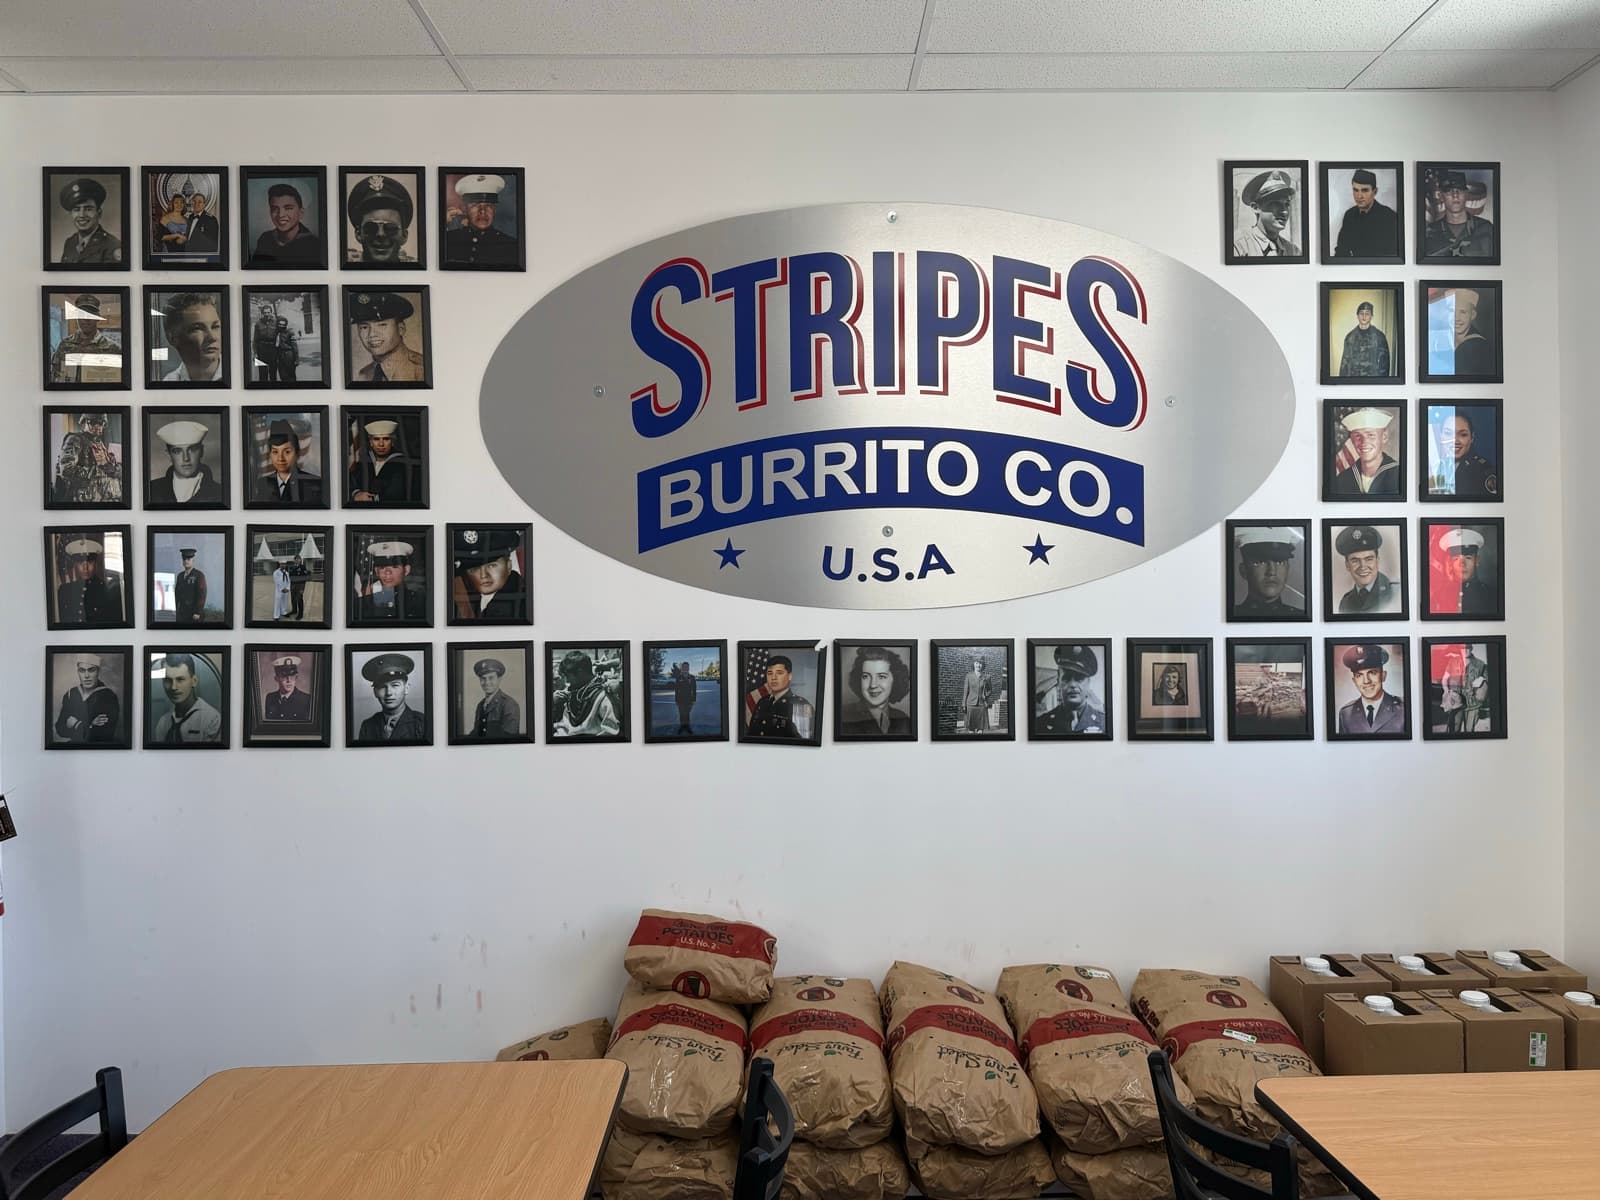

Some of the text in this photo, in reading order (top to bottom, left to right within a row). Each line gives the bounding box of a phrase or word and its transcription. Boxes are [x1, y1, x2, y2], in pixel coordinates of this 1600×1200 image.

[630, 250, 1148, 438] STRIPES
[659, 439, 1134, 530] BURRITO CO.
[822, 543, 955, 582] U.S.A
[662, 927, 735, 945] POTATOES
[936, 1045, 981, 1069] Select
